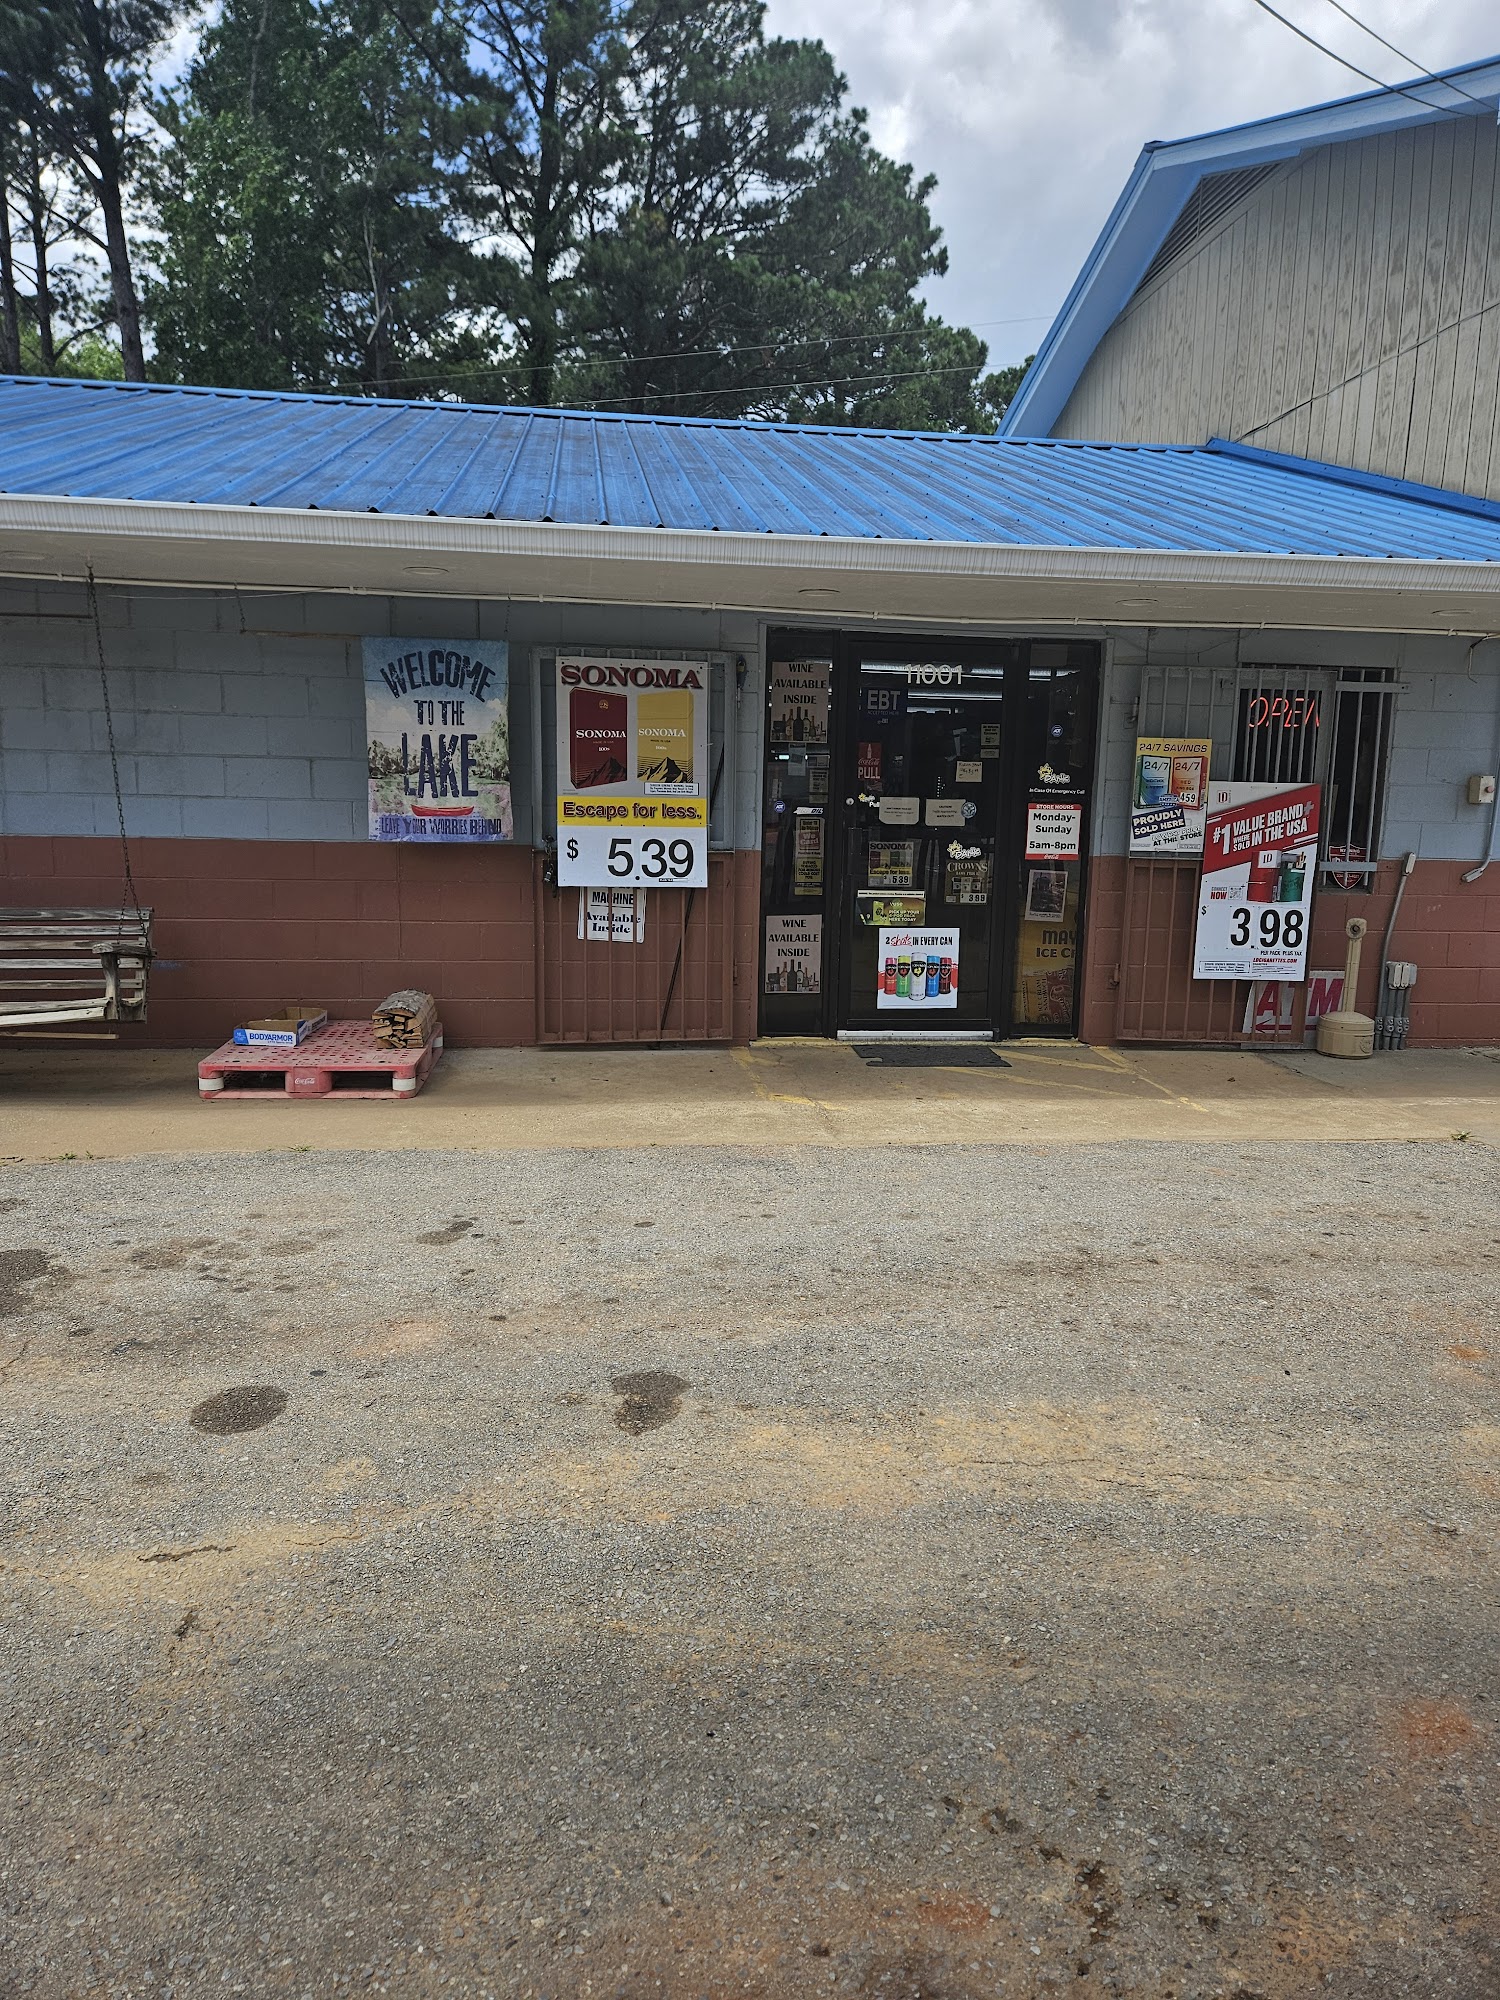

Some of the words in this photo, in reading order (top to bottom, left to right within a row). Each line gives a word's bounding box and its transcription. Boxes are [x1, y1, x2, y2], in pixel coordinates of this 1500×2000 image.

[788, 664, 814, 672] WINE
[380, 649, 496, 702] WELCOME
[560, 664, 704, 689] SONOMA
[905, 664, 962, 684] 11001
[774, 679, 827, 688] AVAILABLE
[784, 694, 816, 704] INSIDE
[867, 690, 900, 710] EBT
[414, 700, 434, 725] TO
[438, 700, 464, 725] THE
[1248, 696, 1320, 728] OPEN
[576, 729, 626, 739] SONOMA
[638, 728, 686, 737] SONOMA
[1140, 744, 1161, 752] 24/7
[1163, 744, 1207, 752] SAVINGS
[402, 732, 478, 798] LAKE
[1144, 762, 1169, 771] 24/7
[1175, 762, 1200, 772] 24/7
[858, 767, 880, 779] PULL
[563, 802, 628, 820] Escape
[632, 802, 657, 818] for
[662, 803, 702, 820] less.
[1034, 812, 1076, 822] Monday-
[1133, 809, 1182, 826] PROUDLY
[381, 818, 400, 833] LEAVE
[402, 818, 426, 834] YOUR
[428, 819, 468, 835] WORRIES
[470, 818, 502, 836] BEHIND
[1035, 825, 1072, 834] Sunday
[1135, 825, 1158, 836] SOLD
[1160, 819, 1184, 829] HERE
[1233, 814, 1266, 836] VALUE
[1181, 832, 1202, 840] STORE
[1251, 831, 1262, 847] IN
[1265, 824, 1284, 842] THE
[1287, 818, 1308, 837] USA
[1213, 824, 1232, 855] #1
[1233, 834, 1250, 844] WHERE
[1029, 841, 1076, 850] 5am-8pm
[1233, 841, 1250, 852] SOLD
[566, 837, 579, 861] $
[608, 838, 694, 880] 5.39
[947, 863, 988, 872] CROWNS
[782, 920, 806, 928] WINE
[1201, 906, 1207, 915] $
[1230, 908, 1304, 949] 3.98
[769, 934, 819, 942] AVAILABLE
[913, 937, 919, 945] IN
[921, 937, 939, 945] EVERY
[940, 937, 953, 945] CAN
[777, 948, 810, 956] INSIDE
[1036, 948, 1057, 958] ICE
[1256, 978, 1344, 1016] AM
[250, 1033, 293, 1042] BODYARMOR
